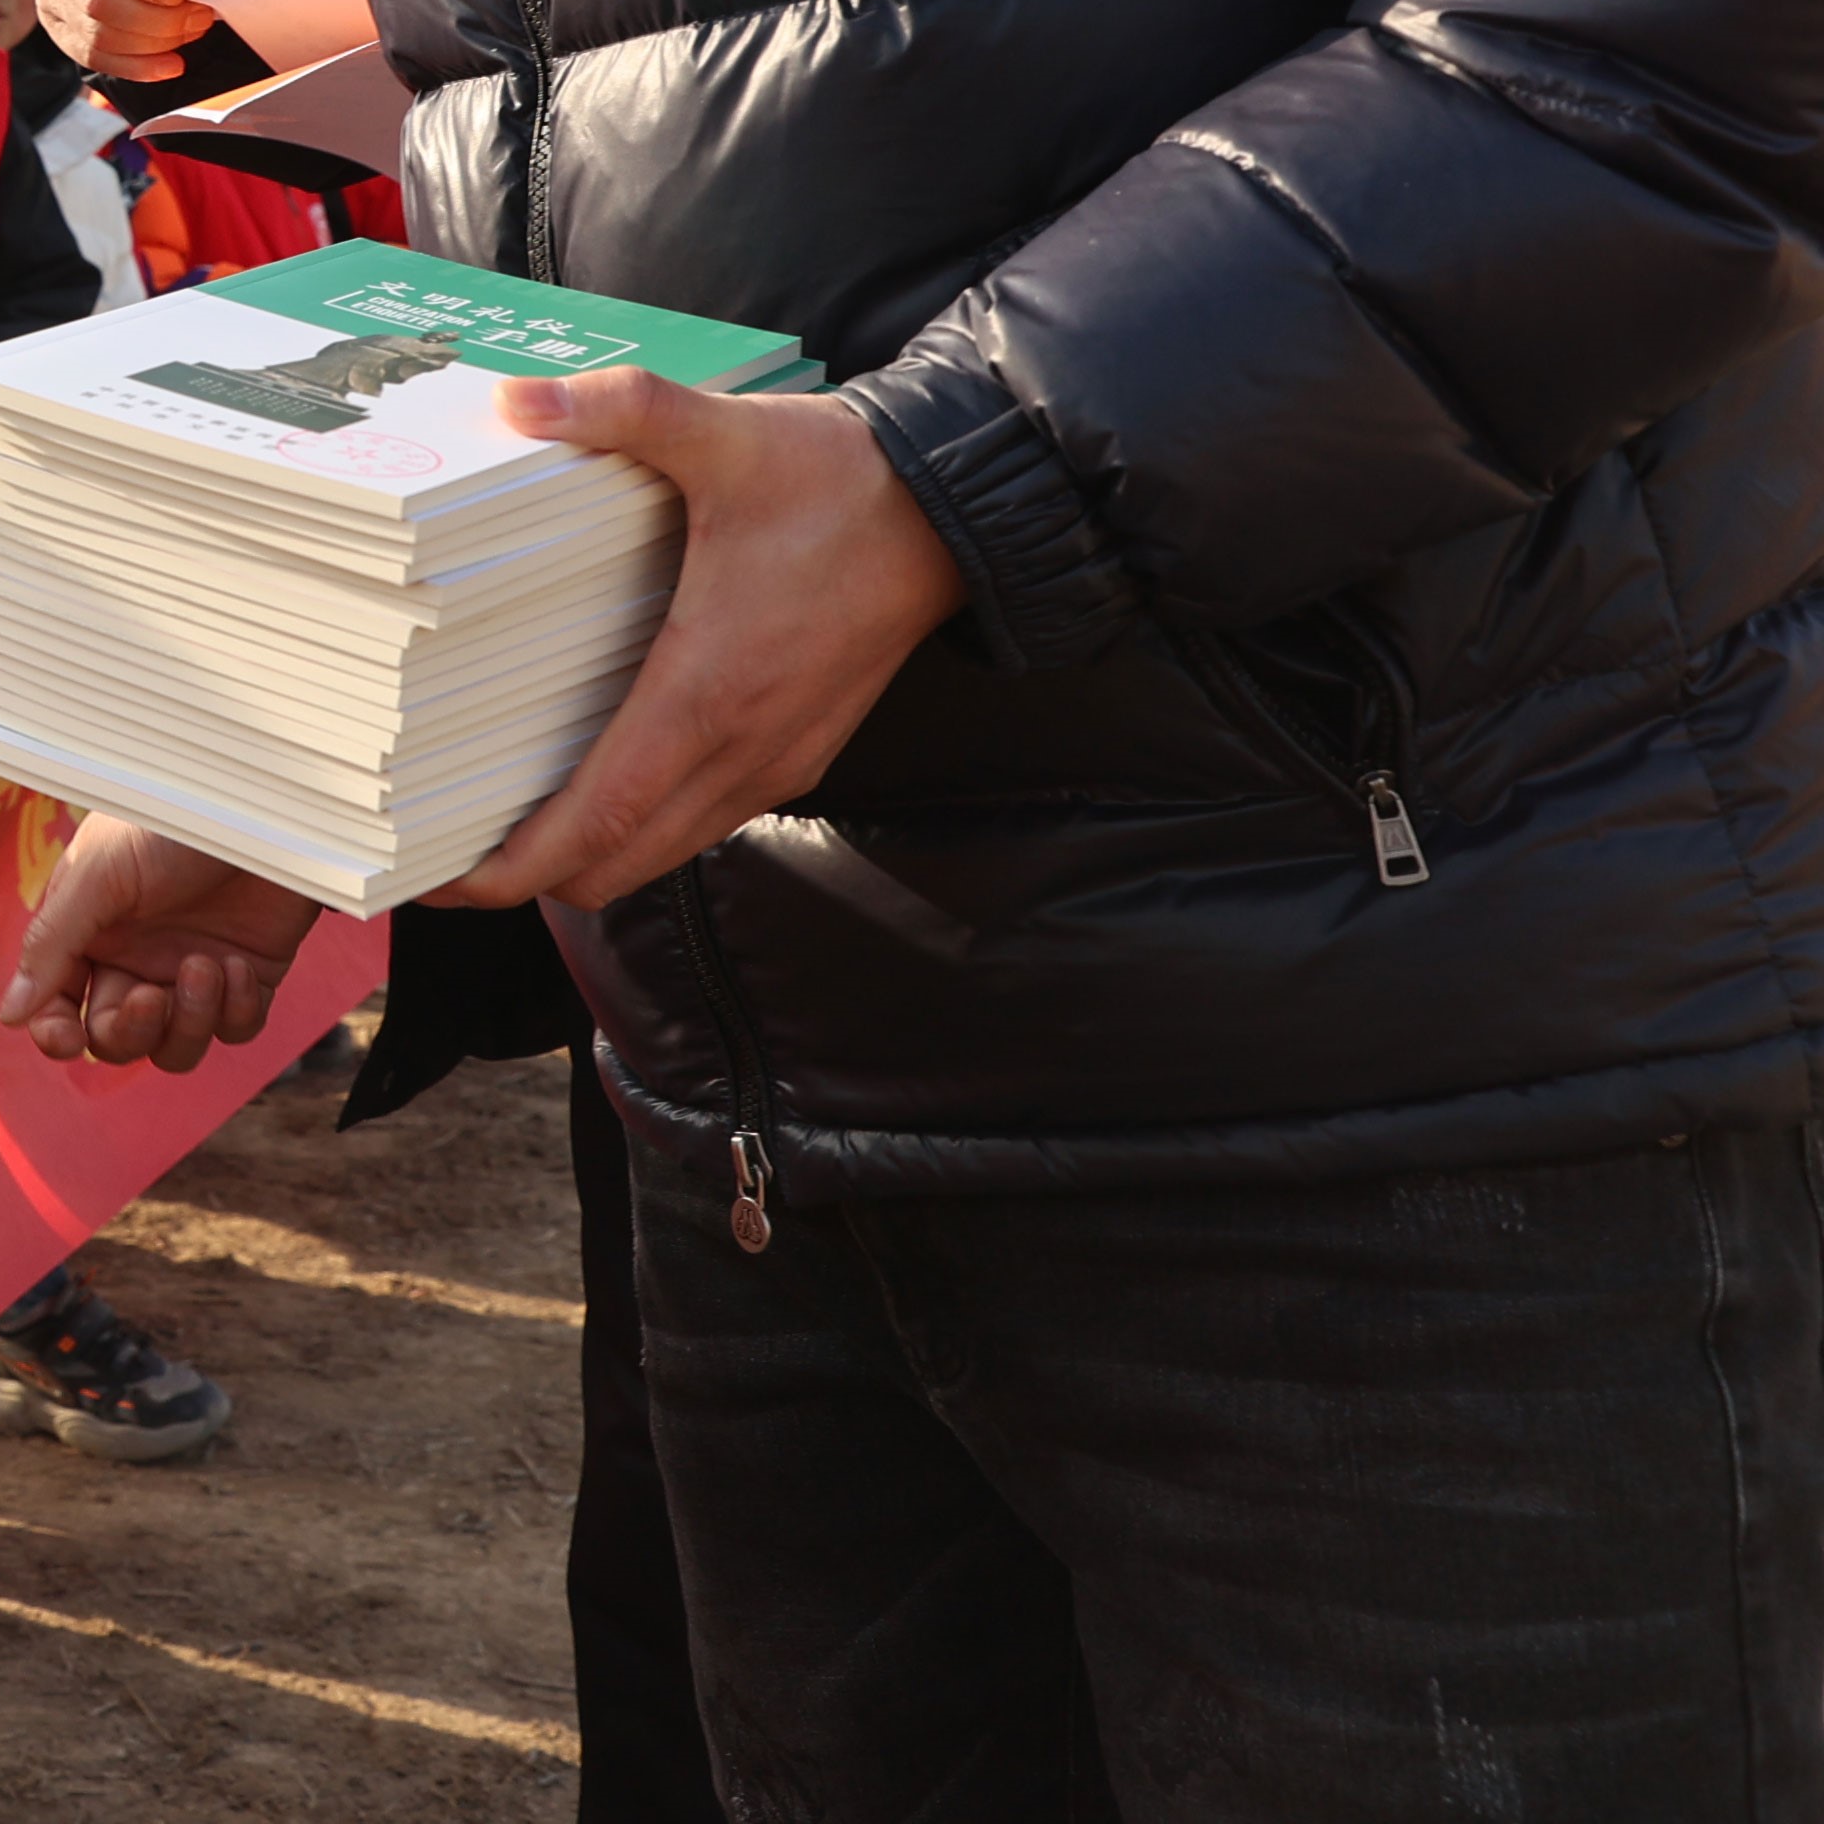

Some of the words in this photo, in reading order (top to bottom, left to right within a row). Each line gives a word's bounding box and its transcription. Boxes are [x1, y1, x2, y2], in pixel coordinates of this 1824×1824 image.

[349, 301, 444, 329] ETIQUETTE
[365, 280, 575, 336] 文明礼仪
[366, 295, 477, 327] CIVILIZATION
[474, 328, 588, 359] 手册
